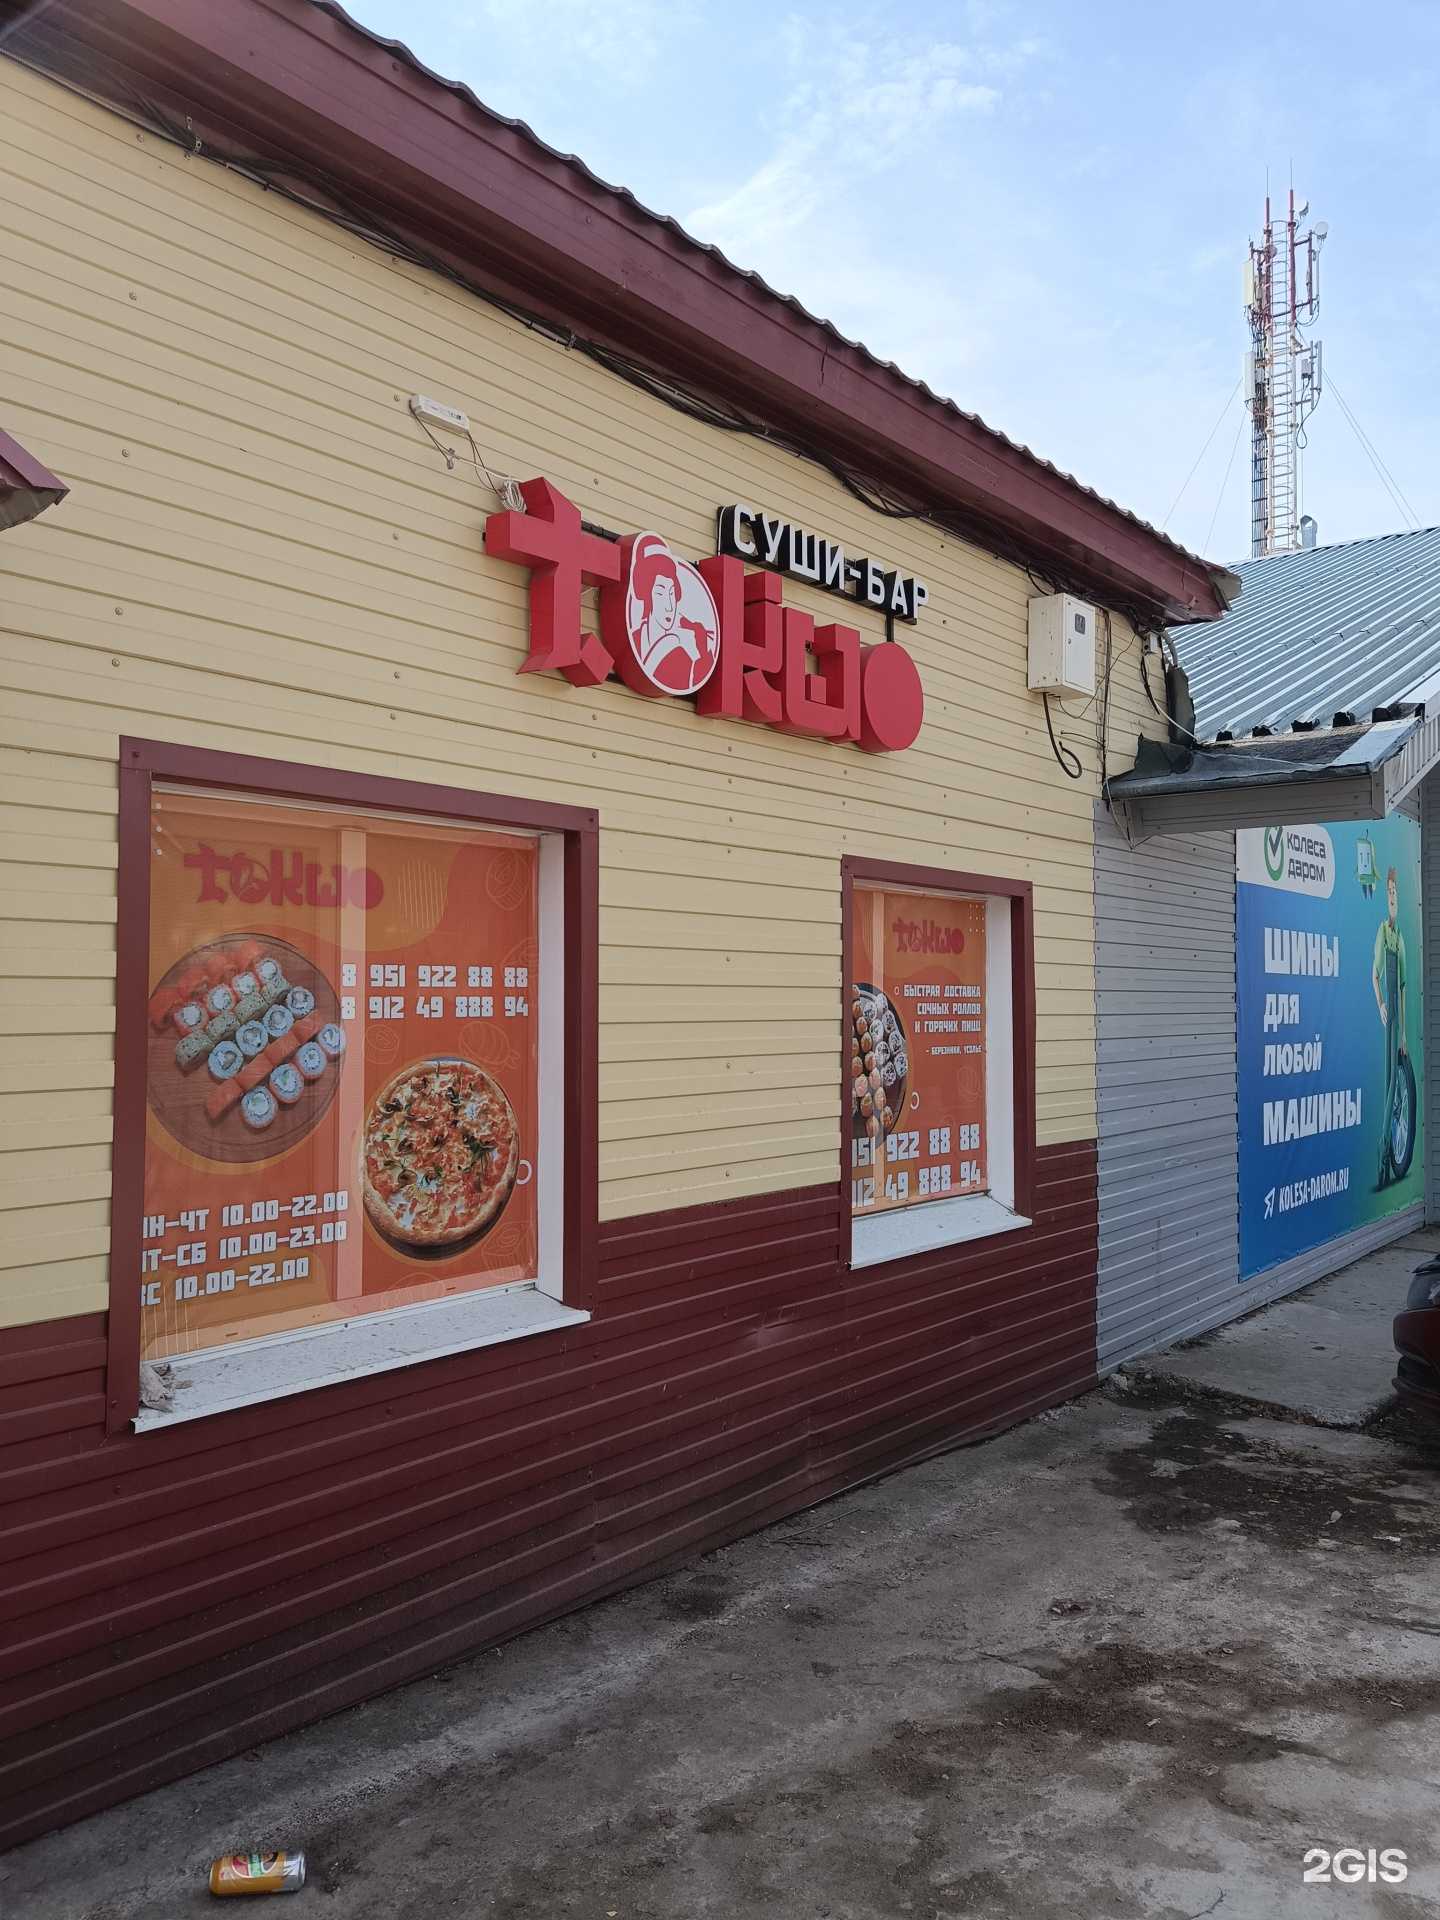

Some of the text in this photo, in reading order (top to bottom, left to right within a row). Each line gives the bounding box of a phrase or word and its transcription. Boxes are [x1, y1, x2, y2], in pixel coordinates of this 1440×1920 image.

[730, 503, 930, 621] СУШИ-БАР
[1264, 926, 1340, 978] ШИНЫ
[342, 963, 528, 987] 8 951 922 88 88
[903, 984, 981, 998] БЫСТРАЯ ДОСТАВКА
[341, 995, 528, 1020] 8 912 49 888 94
[914, 1021, 921, 1033] И
[924, 1020, 959, 1033] ГОРЯЧИХ
[917, 1002, 981, 1015] СОЧНЫХ РОЛЛОВ
[1263, 993, 1300, 1033] ДЛЯ
[1263, 1034, 1322, 1077] ЛЮБОЙ
[1263, 1088, 1362, 1146] МАШИНЫ
[886, 1131, 920, 1162] 922
[929, 1127, 951, 1156] 88
[959, 1123, 980, 1151] 88
[885, 1171, 909, 1200] 49
[918, 1164, 952, 1195] 888
[960, 1160, 981, 1188] 94
[222, 1190, 348, 1228] 10.00-22.00
[219, 1220, 347, 1260] 10.00-23.00
[175, 1257, 309, 1301] 10.00-22.00
